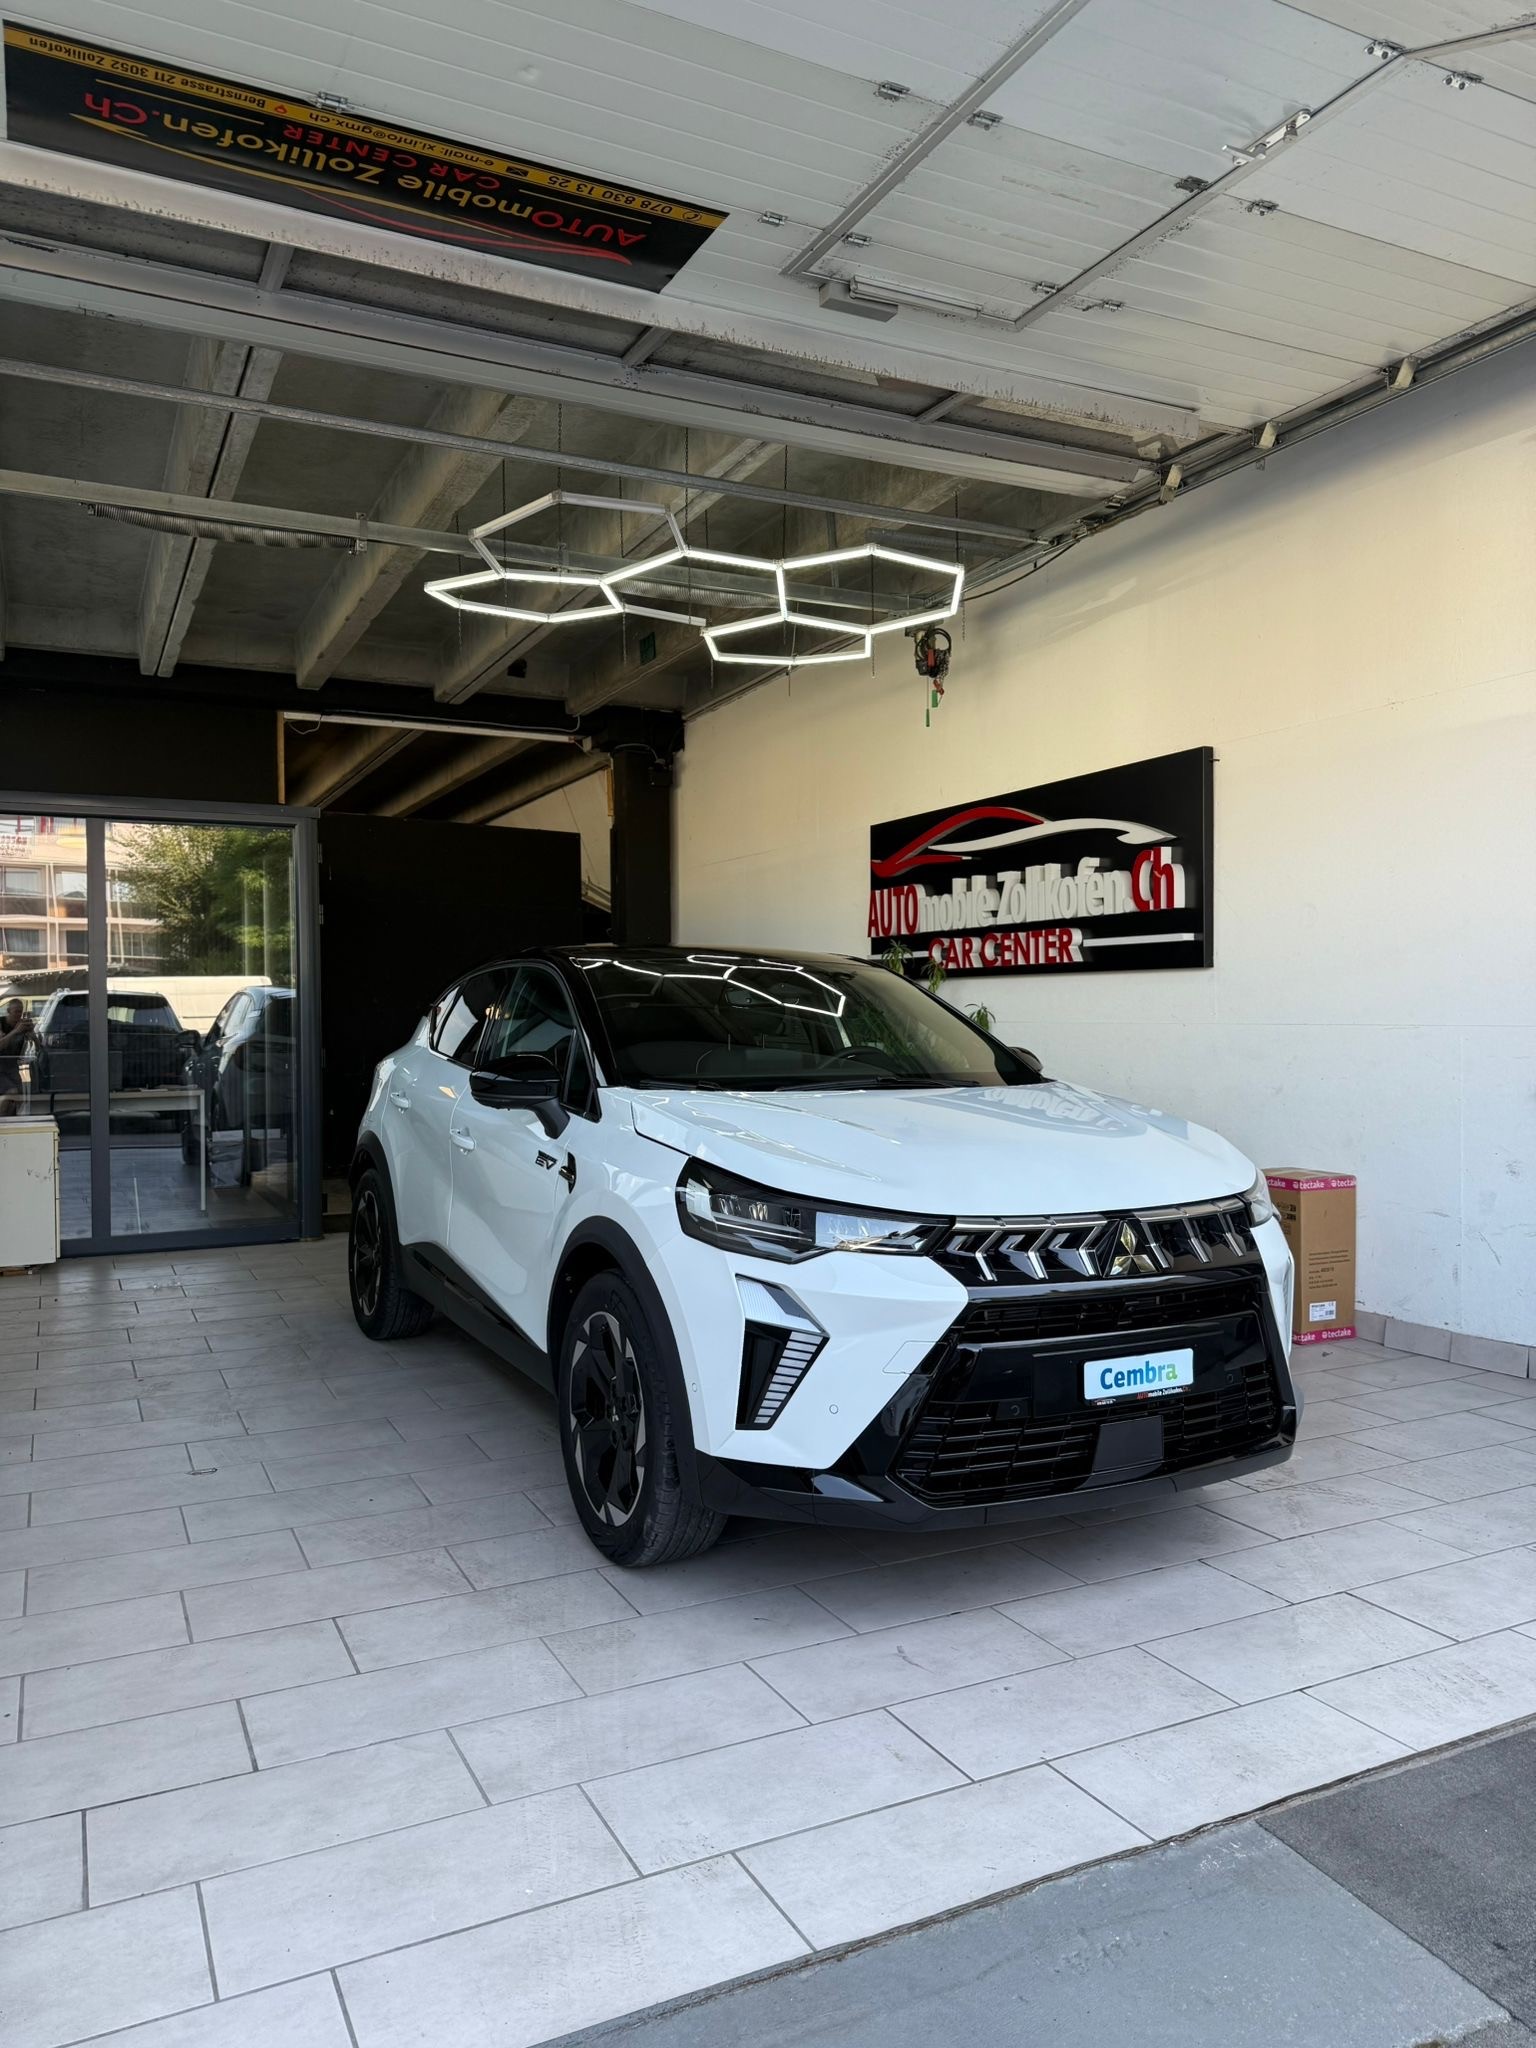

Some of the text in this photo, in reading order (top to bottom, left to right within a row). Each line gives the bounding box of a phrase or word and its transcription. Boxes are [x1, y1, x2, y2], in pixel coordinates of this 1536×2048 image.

[29, 36, 673, 215] 078 830 13 25 e-mail: xi.info@gmx.ch Bernstrasse 211 3052 Zollikofen
[283, 124, 500, 190] CAR CENTER
[84, 92, 647, 247] AUTOmobile Zollikofen.Ch
[867, 846, 1184, 938] AUTOmobile Zollikofen.Ch
[928, 927, 1080, 969] CAR CENTER
[1267, 1179, 1286, 1187] ctake
[1300, 1180, 1325, 1189] tectake
[1100, 1360, 1178, 1390] Cembra
